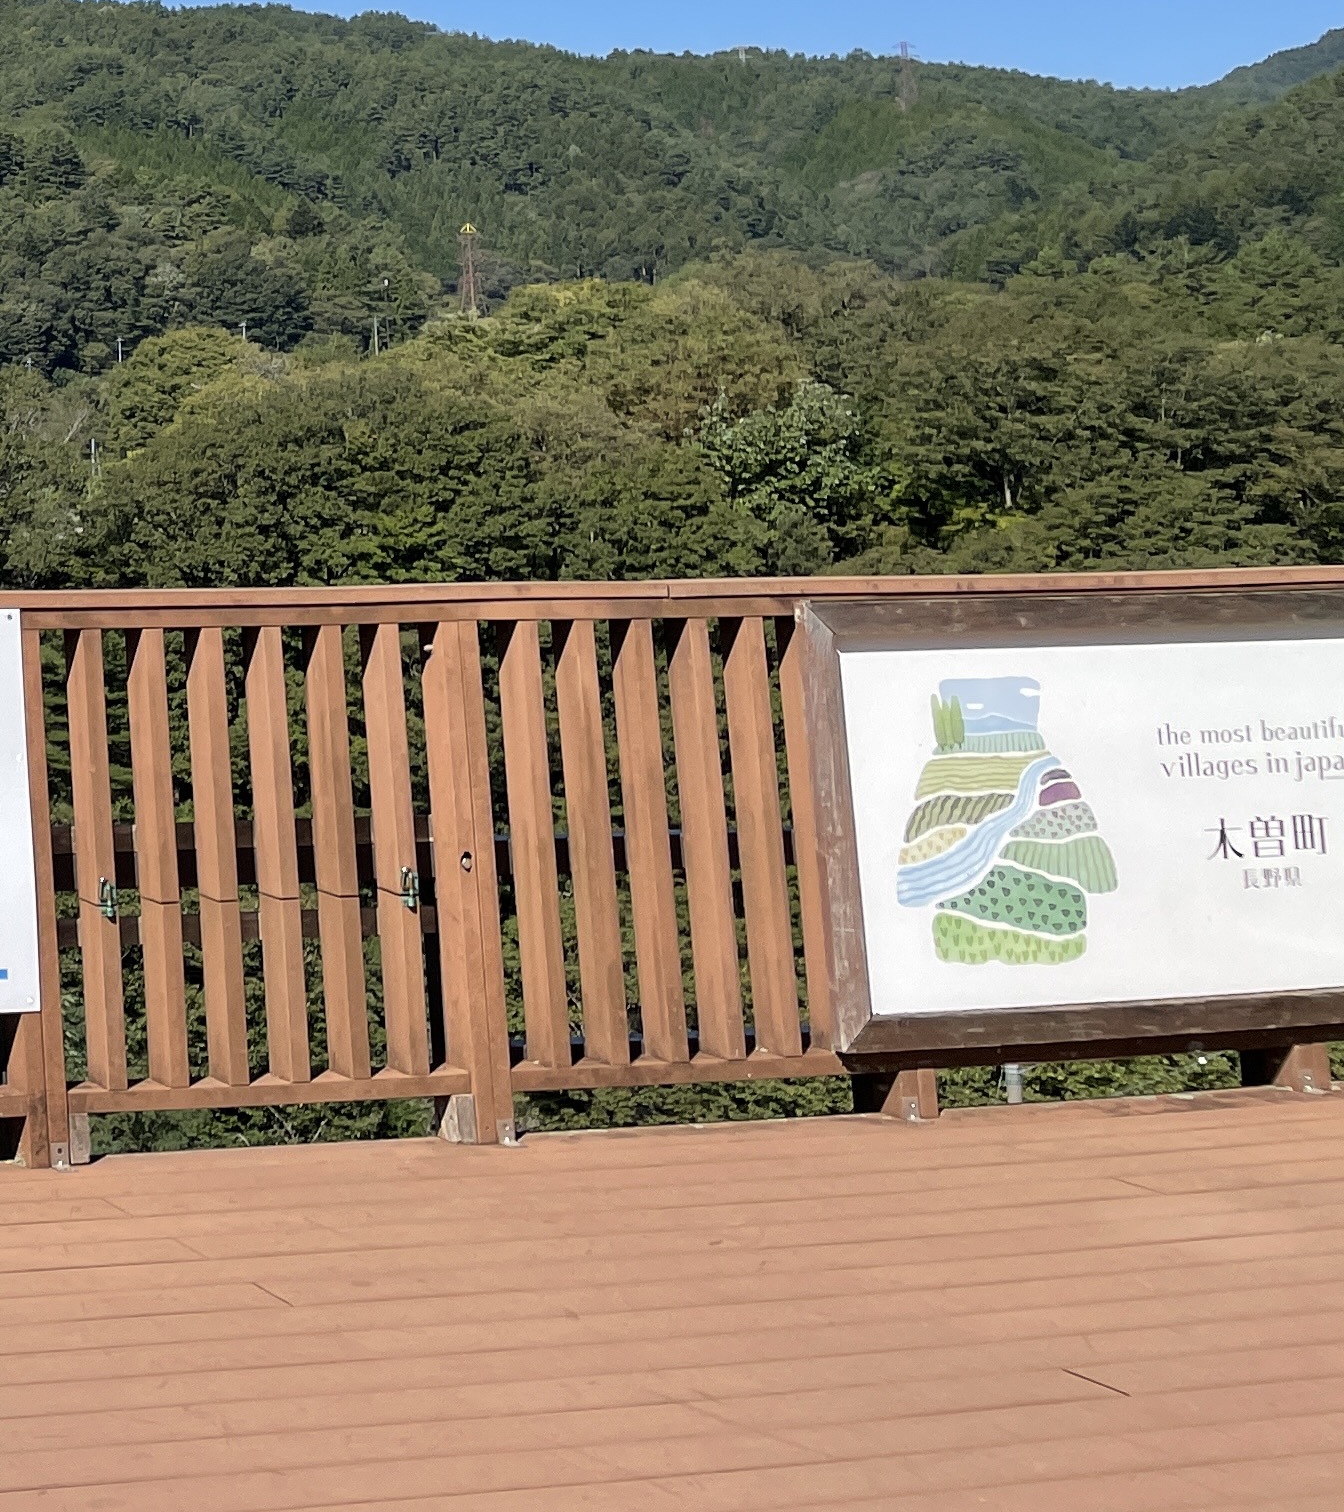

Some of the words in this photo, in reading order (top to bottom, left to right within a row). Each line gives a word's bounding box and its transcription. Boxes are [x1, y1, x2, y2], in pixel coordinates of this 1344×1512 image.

[1156, 722, 1192, 746] the
[1199, 724, 1253, 744] most
[1159, 751, 1259, 781] villages
[1265, 751, 1290, 774] in
[1203, 813, 1330, 861] 木曽町
[1242, 865, 1303, 890] 長野県
